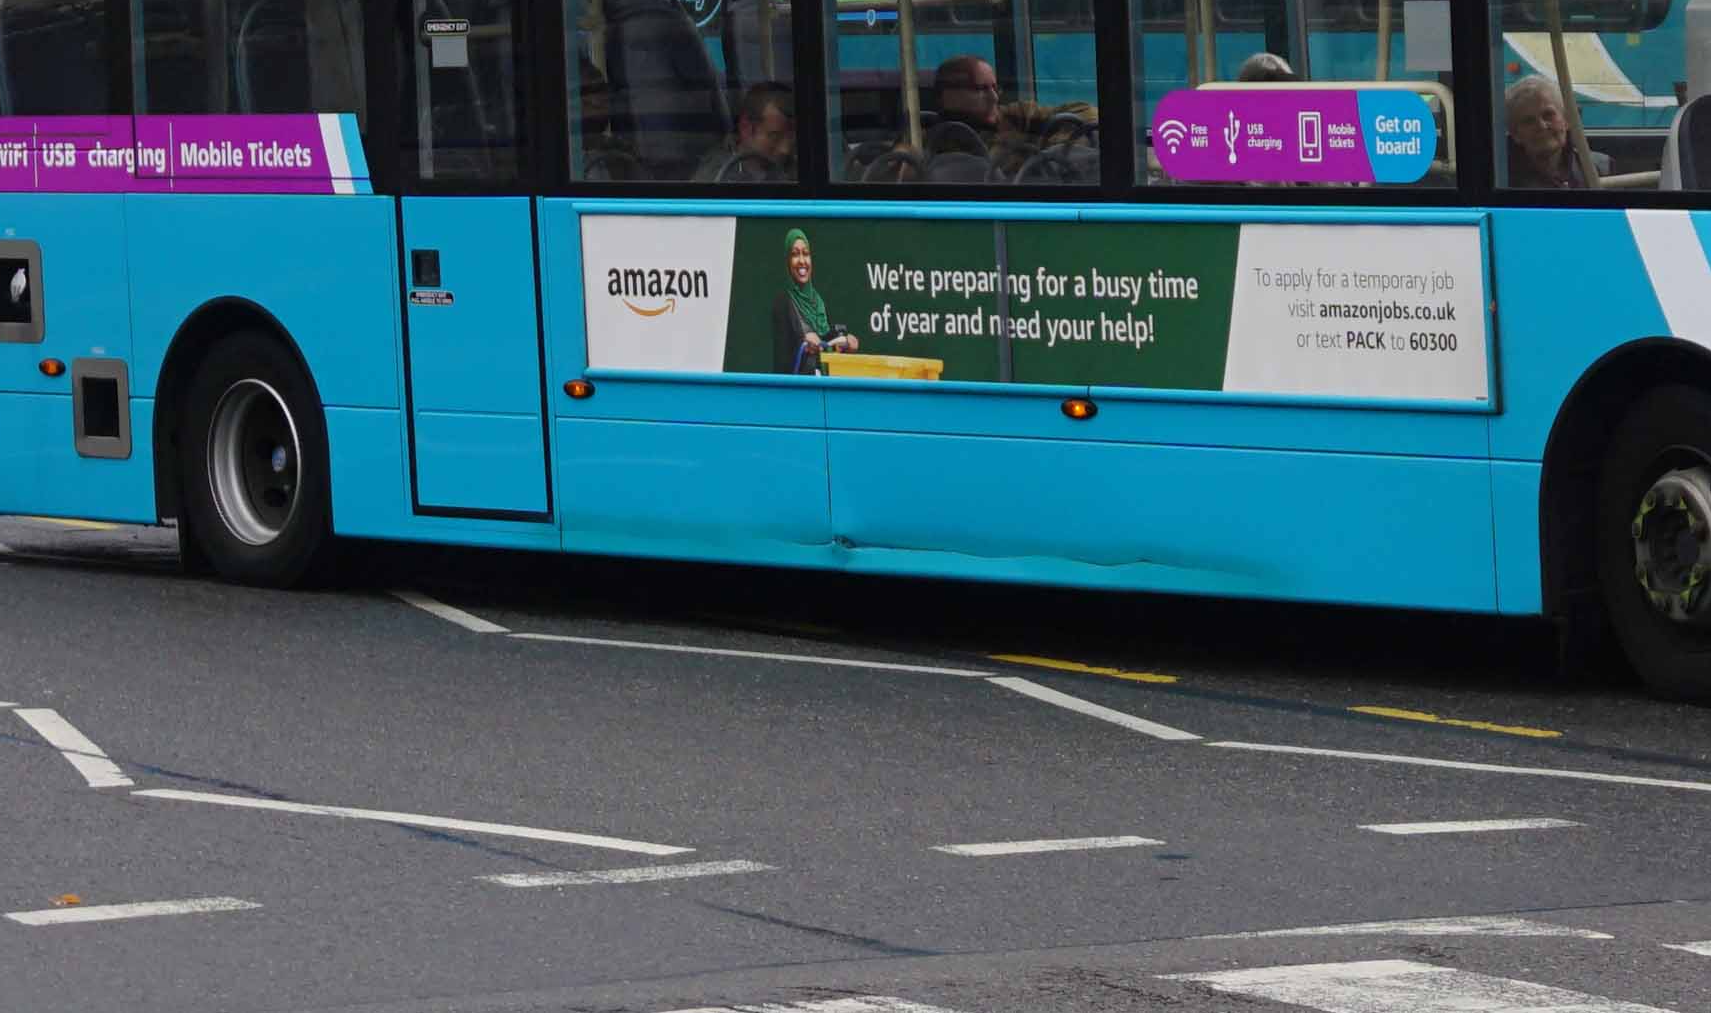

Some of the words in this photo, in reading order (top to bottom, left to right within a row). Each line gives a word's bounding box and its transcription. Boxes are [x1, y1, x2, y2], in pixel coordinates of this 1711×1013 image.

[1190, 124, 1208, 135] Free
[1247, 123, 1264, 135] USB
[1327, 124, 1356, 136] Mobile
[1375, 115, 1400, 133] Get
[1403, 118, 1422, 133] on
[1190, 137, 1209, 148] WiFi
[1247, 137, 1283, 150] charging
[1328, 137, 1355, 148] tickets
[1375, 137, 1422, 156] board!
[42, 142, 77, 167] USB
[87, 141, 166, 173] charging
[180, 141, 244, 168] Mobile
[247, 141, 312, 168] Tickets
[607, 267, 709, 299] amazon
[867, 262, 925, 291] We're
[930, 264, 1031, 303] preparing
[1036, 267, 1069, 297] for
[1074, 273, 1087, 297] a
[1092, 268, 1142, 305] busy
[1148, 270, 1199, 299] time
[1253, 267, 1271, 287] To
[1275, 268, 1313, 292] apply
[1317, 268, 1336, 288] for
[1341, 273, 1349, 288] a
[1353, 271, 1428, 294] temporary
[1431, 270, 1455, 294] job
[1288, 299, 1316, 318] visit
[1319, 300, 1457, 323] amazonjobs.co.uk
[870, 304, 891, 333] of
[896, 309, 940, 339] year
[944, 307, 983, 335] and
[989, 310, 1040, 339] need
[1046, 316, 1095, 347] your
[1100, 312, 1155, 349] help!
[1296, 333, 1311, 348] or
[1315, 332, 1342, 348] text
[1346, 331, 1387, 349] PACK
[1390, 334, 1405, 350] to
[1409, 332, 1457, 351] 60300
